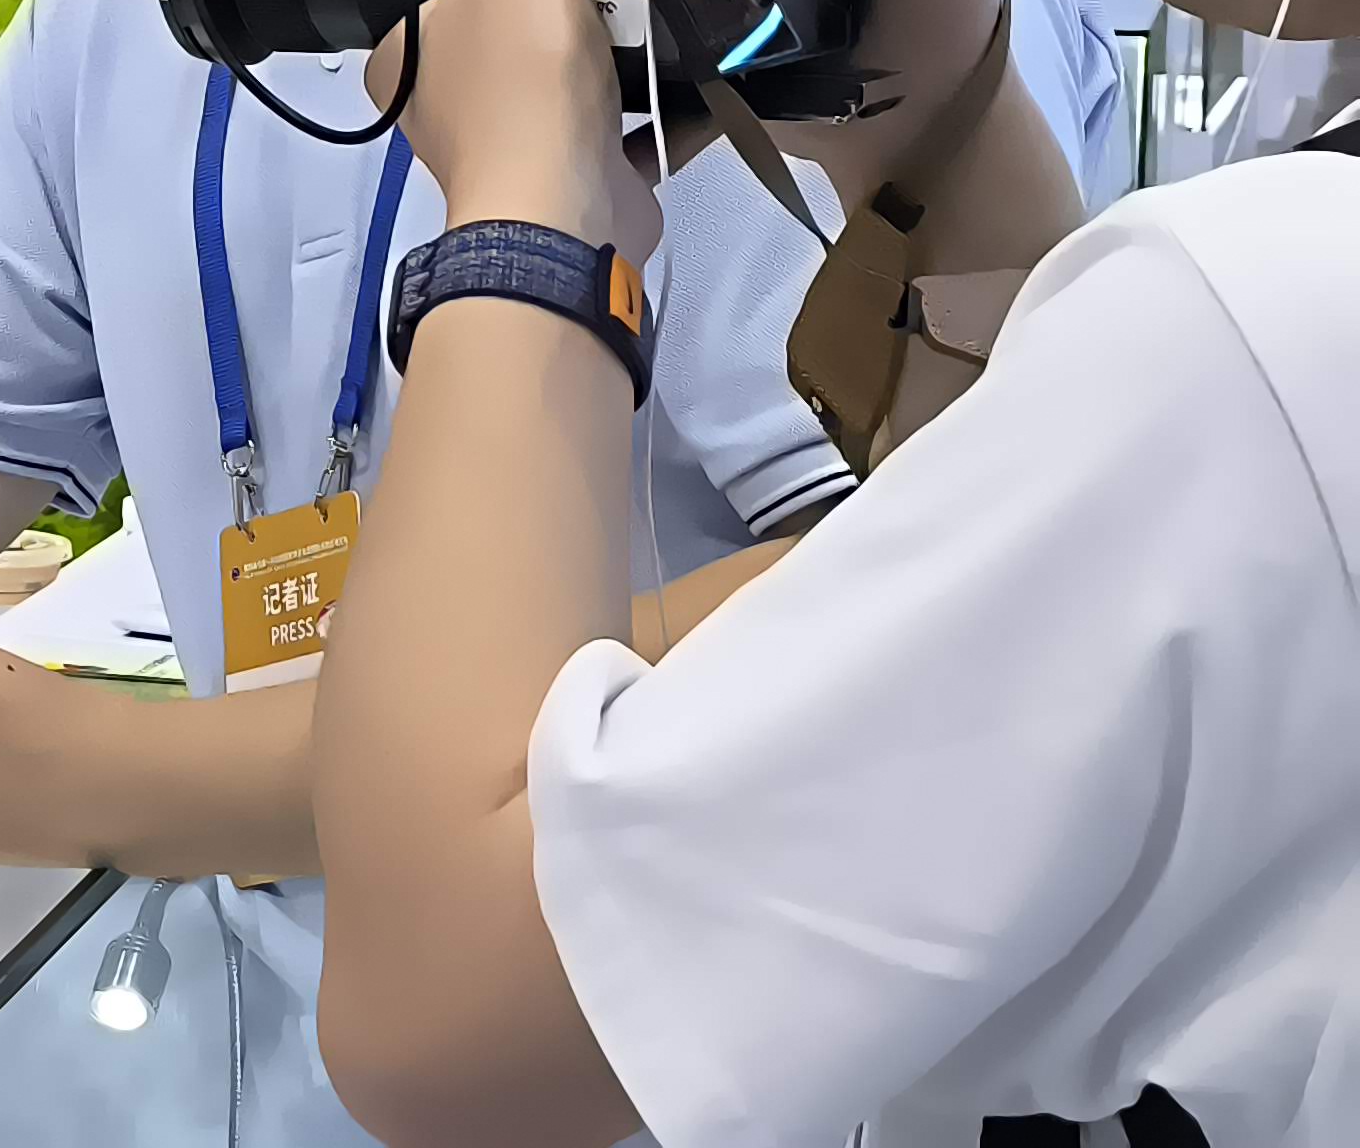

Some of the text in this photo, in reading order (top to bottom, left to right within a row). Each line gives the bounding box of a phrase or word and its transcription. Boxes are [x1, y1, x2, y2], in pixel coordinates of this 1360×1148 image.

[262, 571, 321, 617] 记者证
[271, 616, 315, 647] PRESS
